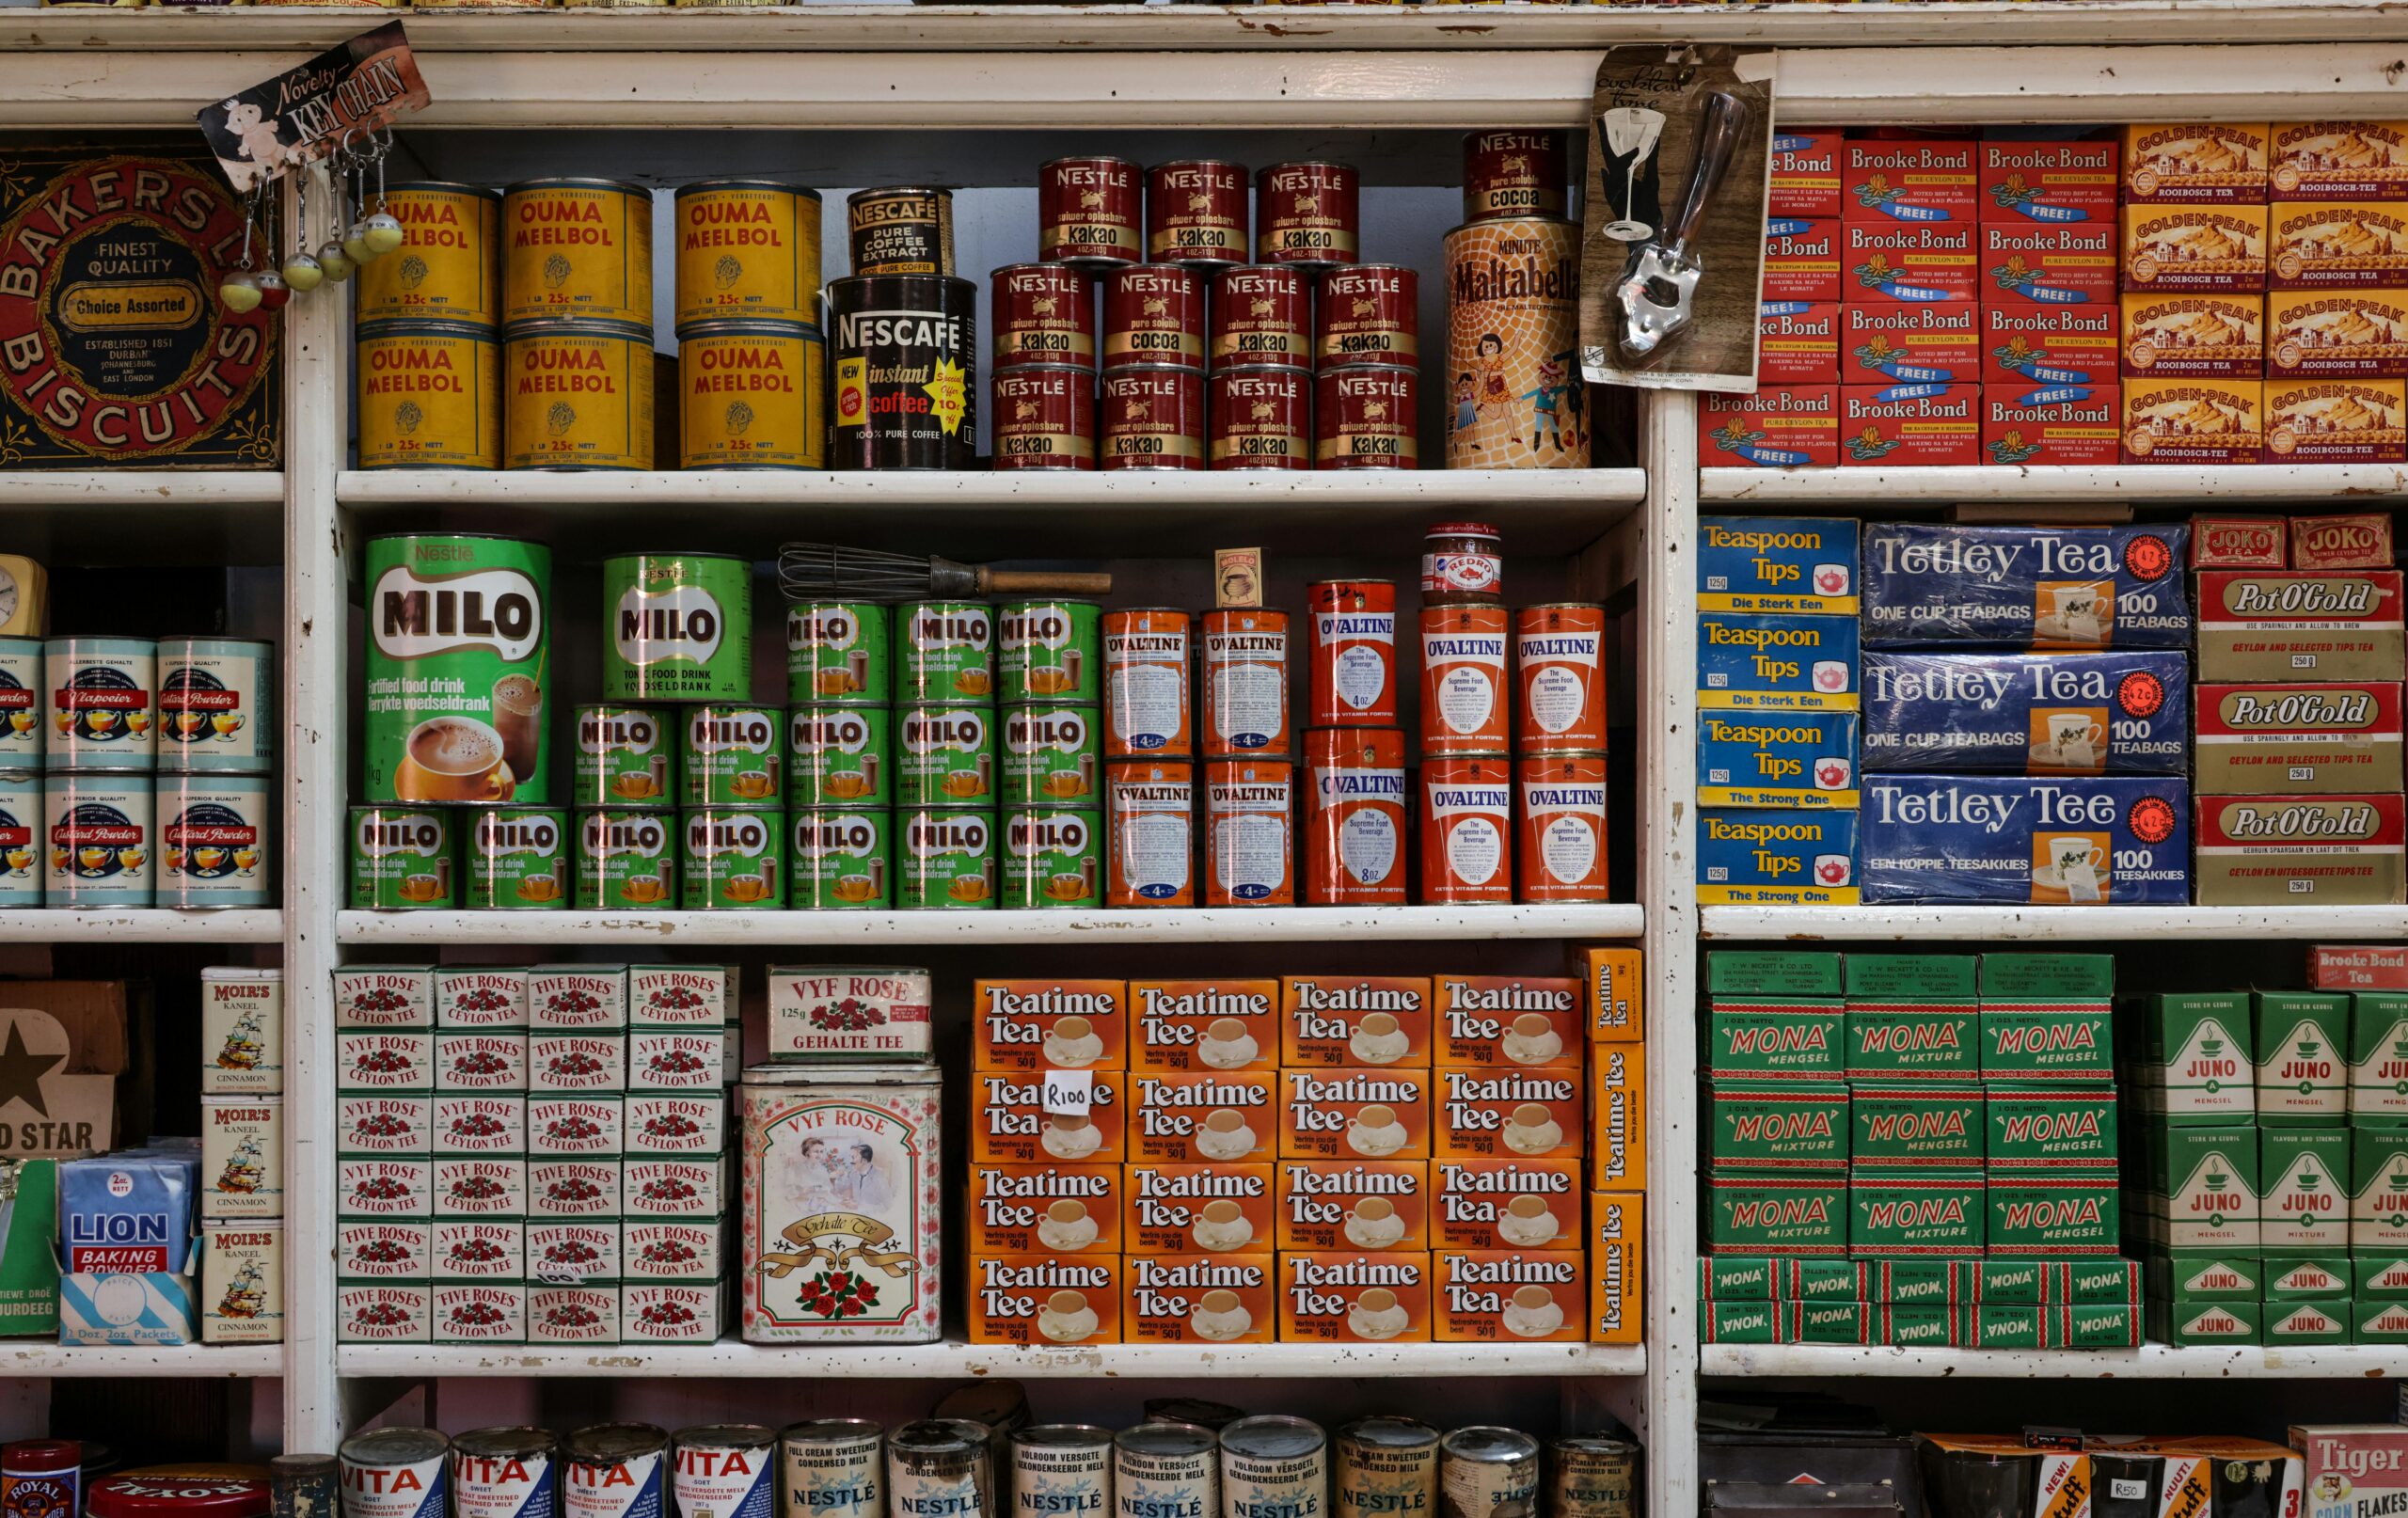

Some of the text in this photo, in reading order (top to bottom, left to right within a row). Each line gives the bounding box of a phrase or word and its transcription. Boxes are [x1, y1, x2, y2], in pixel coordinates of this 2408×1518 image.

[278, 66, 338, 115] Novelty
[287, 55, 407, 147] KEY CHAIN
[1480, 133, 1550, 153] NESTLÉ
[1851, 148, 1968, 169] Brooke Bond
[1057, 167, 1128, 186] NESTLÉ
[1490, 189, 1539, 207] cocoa
[690, 202, 772, 227] OUMA
[852, 197, 937, 223] NESCAFÉ
[1057, 213, 1127, 224] suiwer oplosbare
[1895, 206, 1934, 220] FREE!
[2, 168, 216, 299] BAKERS
[685, 228, 782, 251] MEELBOL
[874, 227, 912, 238] PURE
[1069, 226, 1117, 245] kakao
[99, 242, 159, 259] FINEST
[864, 236, 924, 250] COFFEE
[1498, 240, 1541, 255] MINUTE
[863, 247, 928, 261] EXTRACT
[88, 259, 172, 277] QUALITY
[1454, 260, 1580, 306] Maltabella
[2158, 276, 2210, 284] ROOIBOSCH
[77, 297, 185, 315] Choice Assorted
[840, 311, 959, 350] NESCAFÉ
[85, 338, 173, 351] ESTABLISHED 1851
[109, 350, 149, 360] DURBAN
[103, 374, 154, 384] EAST LONDON
[841, 364, 860, 380] NEW
[869, 365, 929, 385] instant
[4, 324, 261, 446] BISCUITS
[870, 392, 928, 414] coffee
[2272, 385, 2400, 410] GOLDEN-PEAK
[856, 429, 940, 440] 100% PURE COFFEE
[399, 440, 443, 451] 25c NETT
[2296, 446, 2373, 456] ROOIBOSCH-TEE
[1703, 526, 1821, 554] Teaspoon
[2309, 527, 2373, 548] JOKO
[1221, 555, 1256, 565] MOLELO
[1450, 557, 1491, 573] REDRO
[1875, 536, 2120, 582] Tetley Tea
[1751, 558, 1800, 585] Tips
[1708, 577, 1727, 590] 125g
[1732, 598, 1823, 609] Die Sterk Een
[2118, 594, 2156, 613] 100
[383, 590, 532, 639] MILO
[1872, 606, 2031, 620] ONE CUP TEABAGS
[622, 609, 715, 640] MILO
[917, 619, 987, 640] MILO
[2117, 615, 2188, 629] TEABAGS
[1427, 640, 1502, 657] OVALTINE
[2233, 643, 2373, 652] CEYLON AND SELECTED TIPS TEA
[652, 670, 711, 679] FOOD DRINK
[1449, 677, 1468, 686] Supreme
[402, 678, 428, 694] food
[430, 677, 465, 694] drink
[70, 689, 134, 705] Vlapoeier
[404, 695, 490, 712] voedseldrank
[1872, 786, 2115, 833] Tetley Tee
[168, 827, 253, 843] Custard Powder
[1728, 891, 1830, 904] The Strong One
[2320, 953, 2403, 968] Brooke Bond
[2349, 971, 2372, 983] Tea
[214, 986, 269, 1000] MOIR'S
[791, 978, 910, 1001] VYF ROSE
[985, 986, 1116, 1015] Teatime
[347, 1007, 417, 1024] CEYLON TEE
[782, 1008, 805, 1020] 125g
[986, 1016, 1041, 1044] Tea
[793, 1036, 903, 1049] GEHALTE TEE
[1768, 1053, 1830, 1064] MENGSEL
[1898, 1052, 1962, 1063] MIXTURE
[2187, 1060, 2237, 1079] JUNO
[1048, 1086, 1085, 1106] R100
[1605, 1052, 1625, 1180] Teatime Tee
[22, 1123, 93, 1149] STAR
[2282, 1194, 2332, 1211] JUNO
[71, 1214, 167, 1241] LION
[81, 1250, 157, 1264] BAKING
[536, 1273, 575, 1282] 100
[788, 1443, 877, 1456] FULL CREAM SWEETENED
[798, 1457, 868, 1467] CONDENSED MILK
[2320, 1439, 2405, 1478] Tiger
[340, 1467, 422, 1494] VITA
[2044, 1462, 2069, 1494] NEW!
[2163, 1462, 2192, 1500] NUUT!
[11, 1478, 59, 1501] ROYAL
[794, 1481, 875, 1506] NESTLÉ
[2115, 1483, 2138, 1497] R50
[2357, 1492, 2407, 1518] FLAKES
